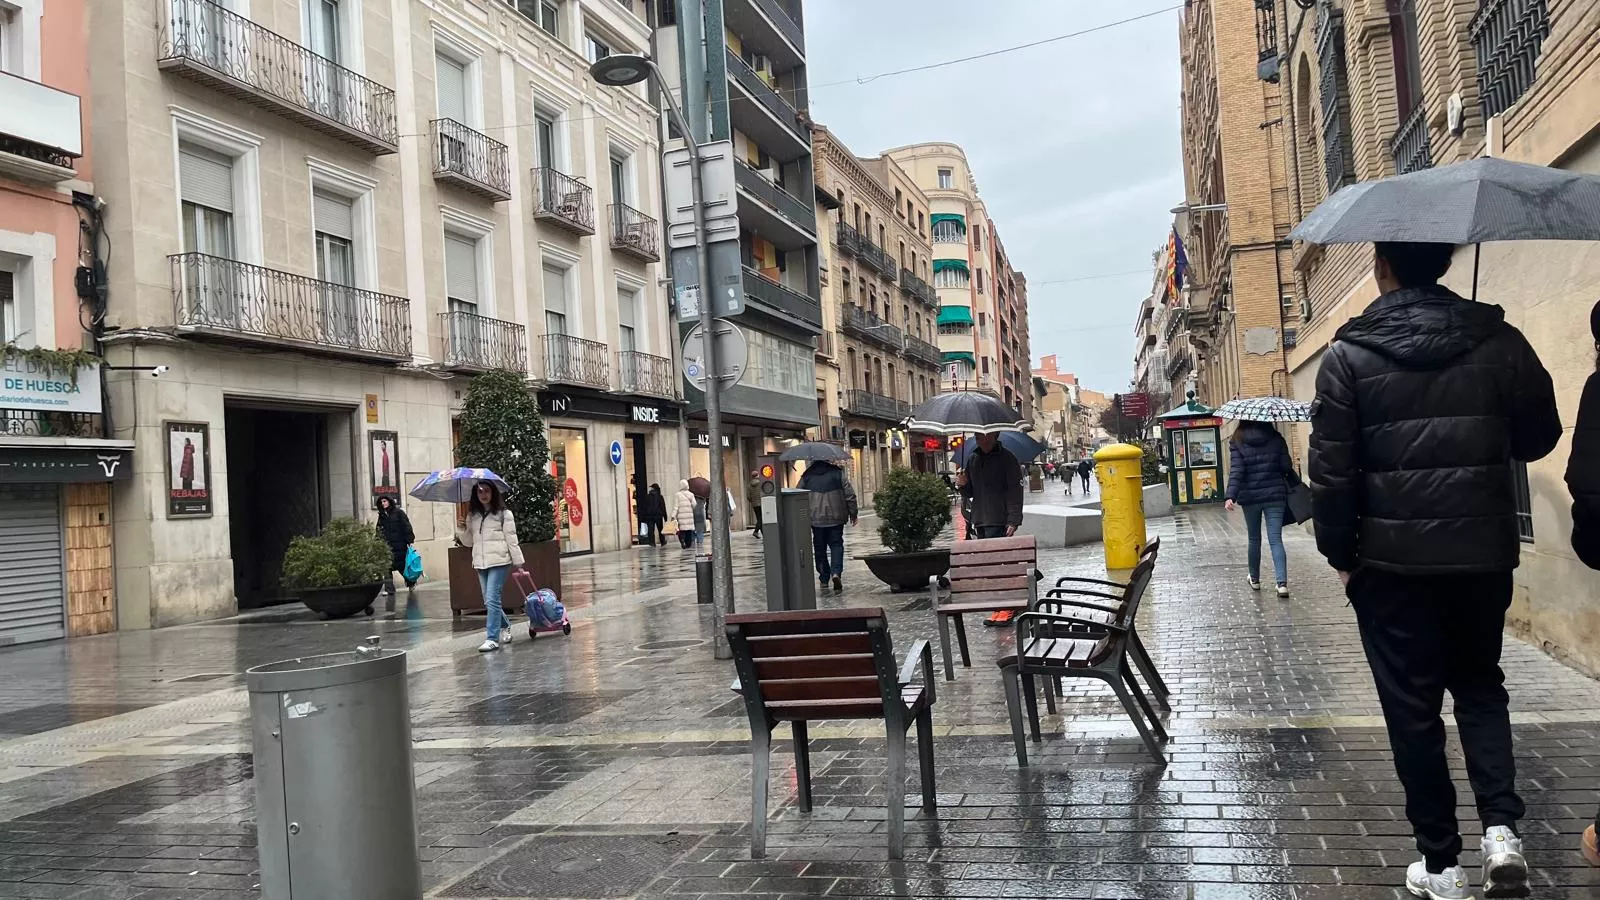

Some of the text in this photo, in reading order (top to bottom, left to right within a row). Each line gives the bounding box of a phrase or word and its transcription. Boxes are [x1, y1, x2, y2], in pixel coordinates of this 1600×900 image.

[5, 378, 80, 393] DE HUESCA
[552, 399, 566, 411] IN
[633, 406, 659, 423] INSIDE
[171, 489, 208, 498] REBAJAS
